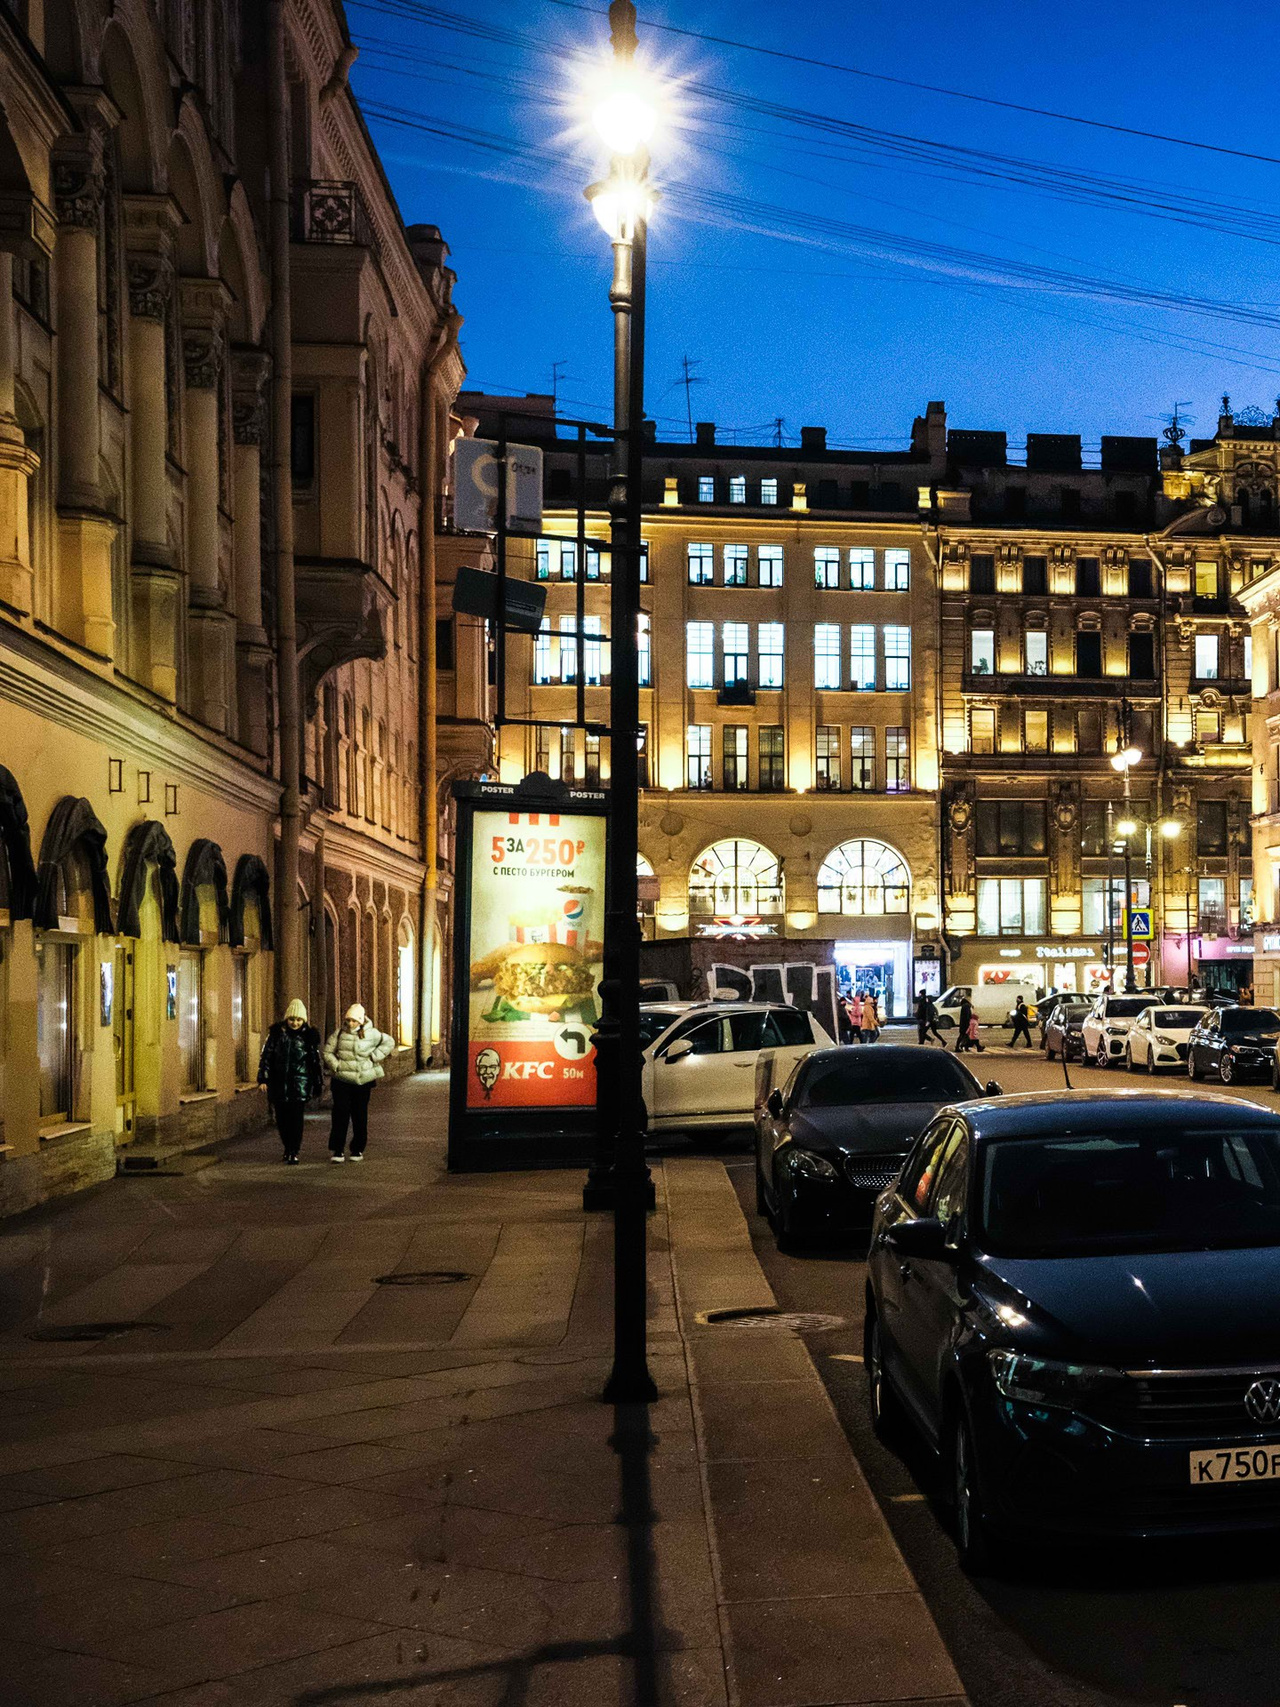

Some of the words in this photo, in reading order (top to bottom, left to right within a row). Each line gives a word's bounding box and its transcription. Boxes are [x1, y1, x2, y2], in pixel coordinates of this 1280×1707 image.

[481, 785, 515, 794] POSTER
[569, 791, 606, 800] POSTER
[491, 836, 505, 863] 5
[493, 866, 498, 875] С
[501, 867, 527, 876] ПЕСТО
[530, 868, 575, 878] БУРГЕРОМ
[501, 1061, 555, 1080] KFC
